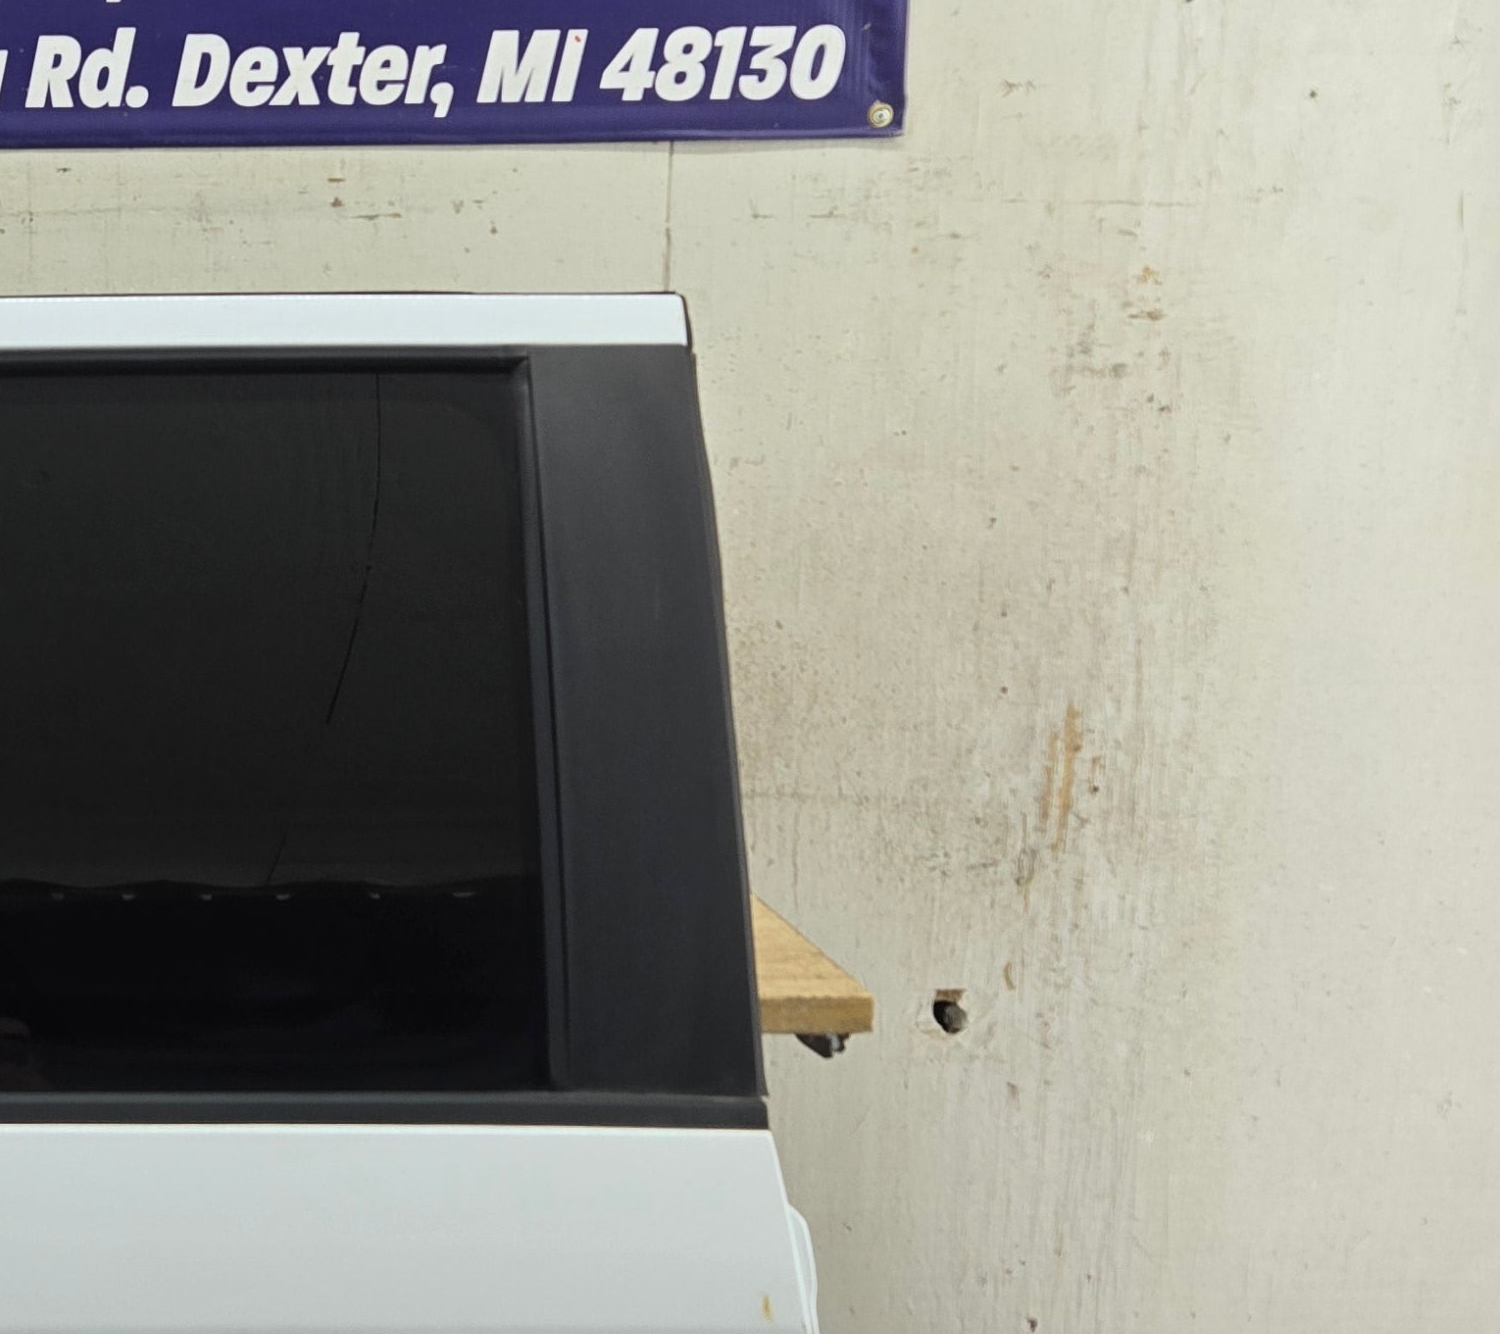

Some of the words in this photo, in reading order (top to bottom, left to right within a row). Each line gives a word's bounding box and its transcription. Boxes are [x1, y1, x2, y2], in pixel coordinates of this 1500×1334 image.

[23, 26, 150, 110] Rd.
[170, 30, 455, 119] Dexter,
[475, 27, 590, 105] MI
[598, 23, 847, 103] 48130
